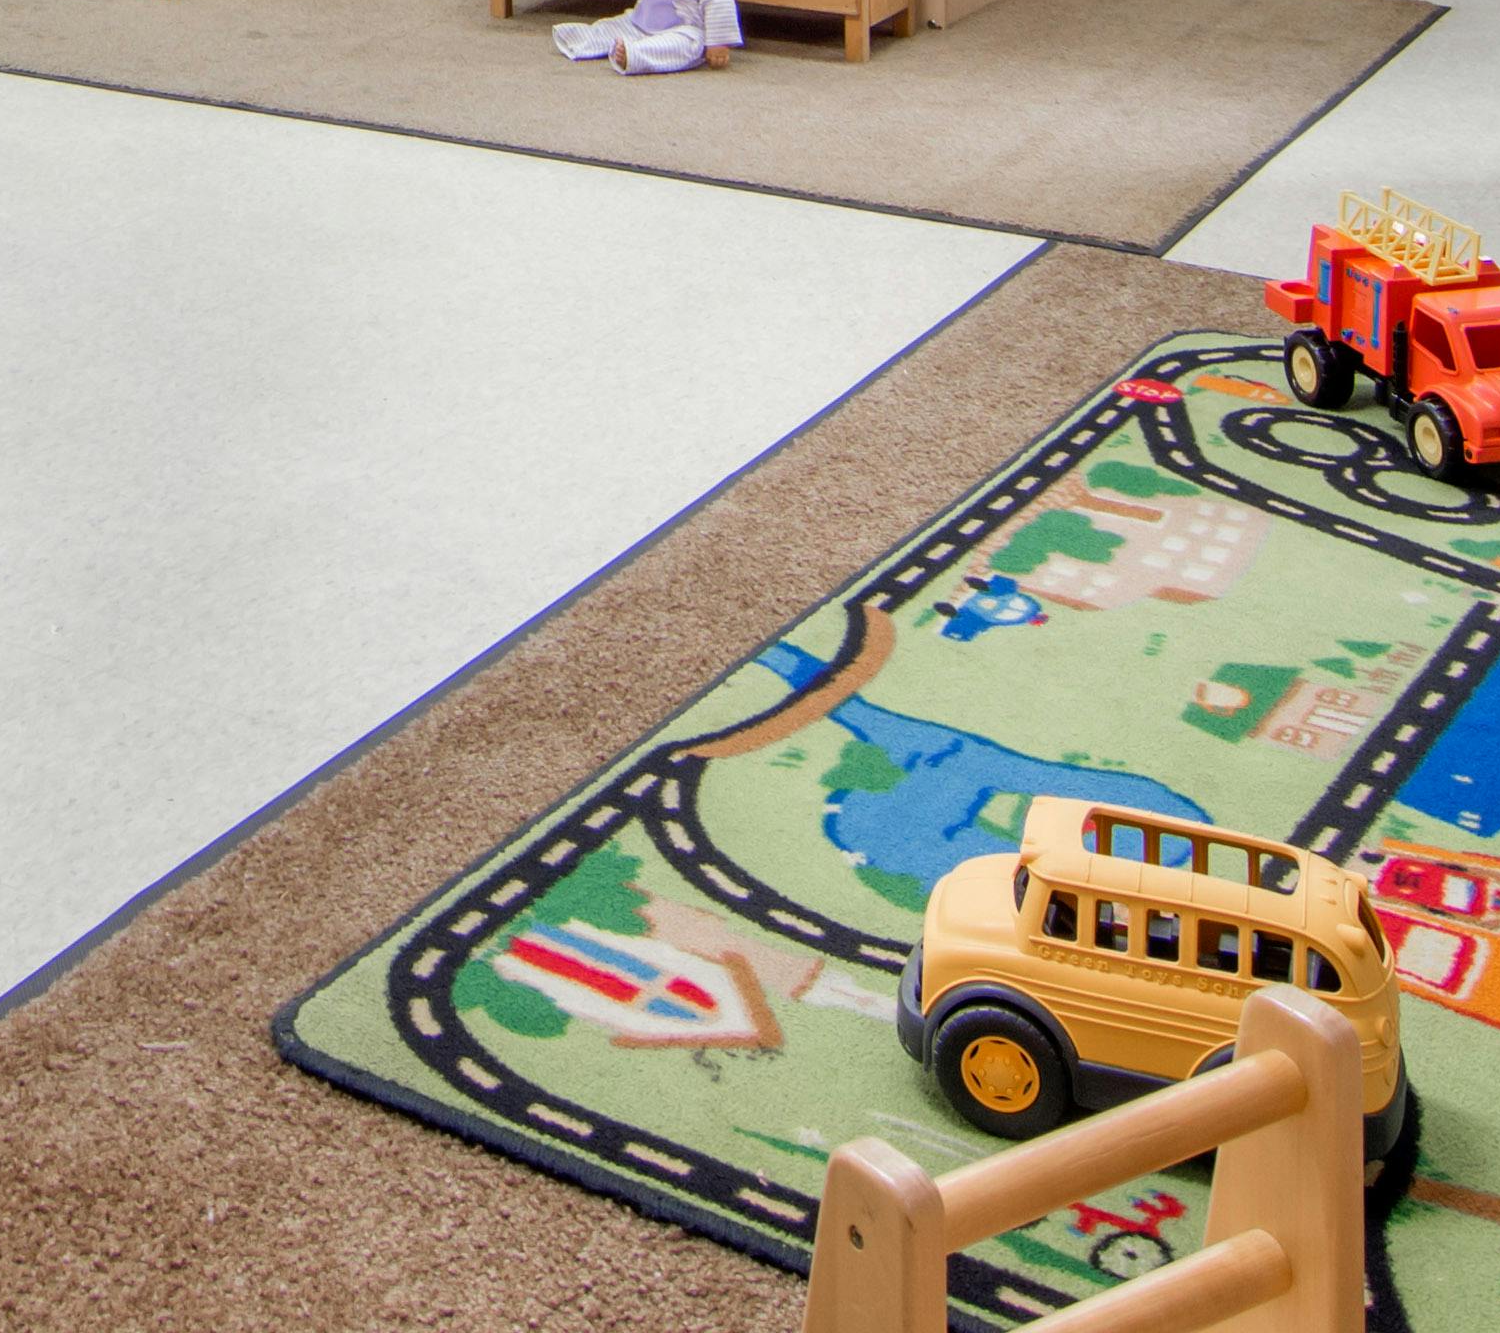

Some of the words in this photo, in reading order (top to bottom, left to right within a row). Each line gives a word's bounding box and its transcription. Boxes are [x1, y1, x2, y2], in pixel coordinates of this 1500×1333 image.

[1117, 382, 1180, 399] STOP
[1037, 943, 1111, 972] Green
[1124, 962, 1184, 988] Toys
